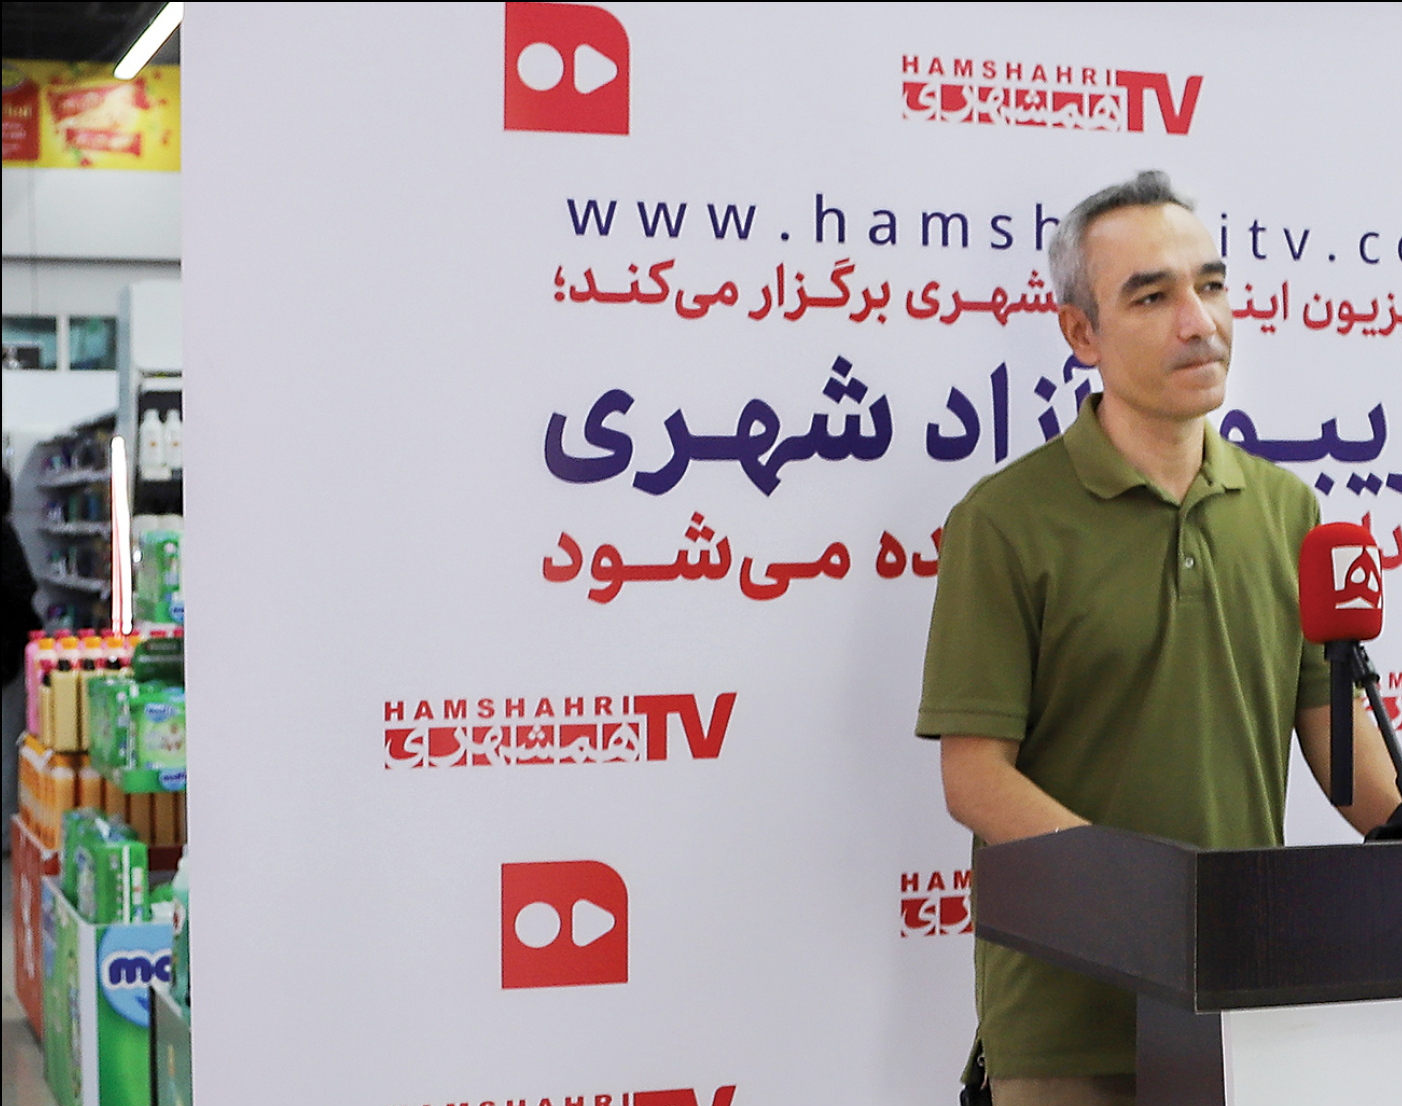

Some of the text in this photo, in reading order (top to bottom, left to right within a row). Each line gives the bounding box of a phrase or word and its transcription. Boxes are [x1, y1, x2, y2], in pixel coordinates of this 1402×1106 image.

[902, 55, 1204, 135] HAMSHAHRI TV
[747, 258, 891, 324] برگزار
[544, 355, 893, 498] شهری
[385, 692, 738, 761] HAMSHAHRI TV
